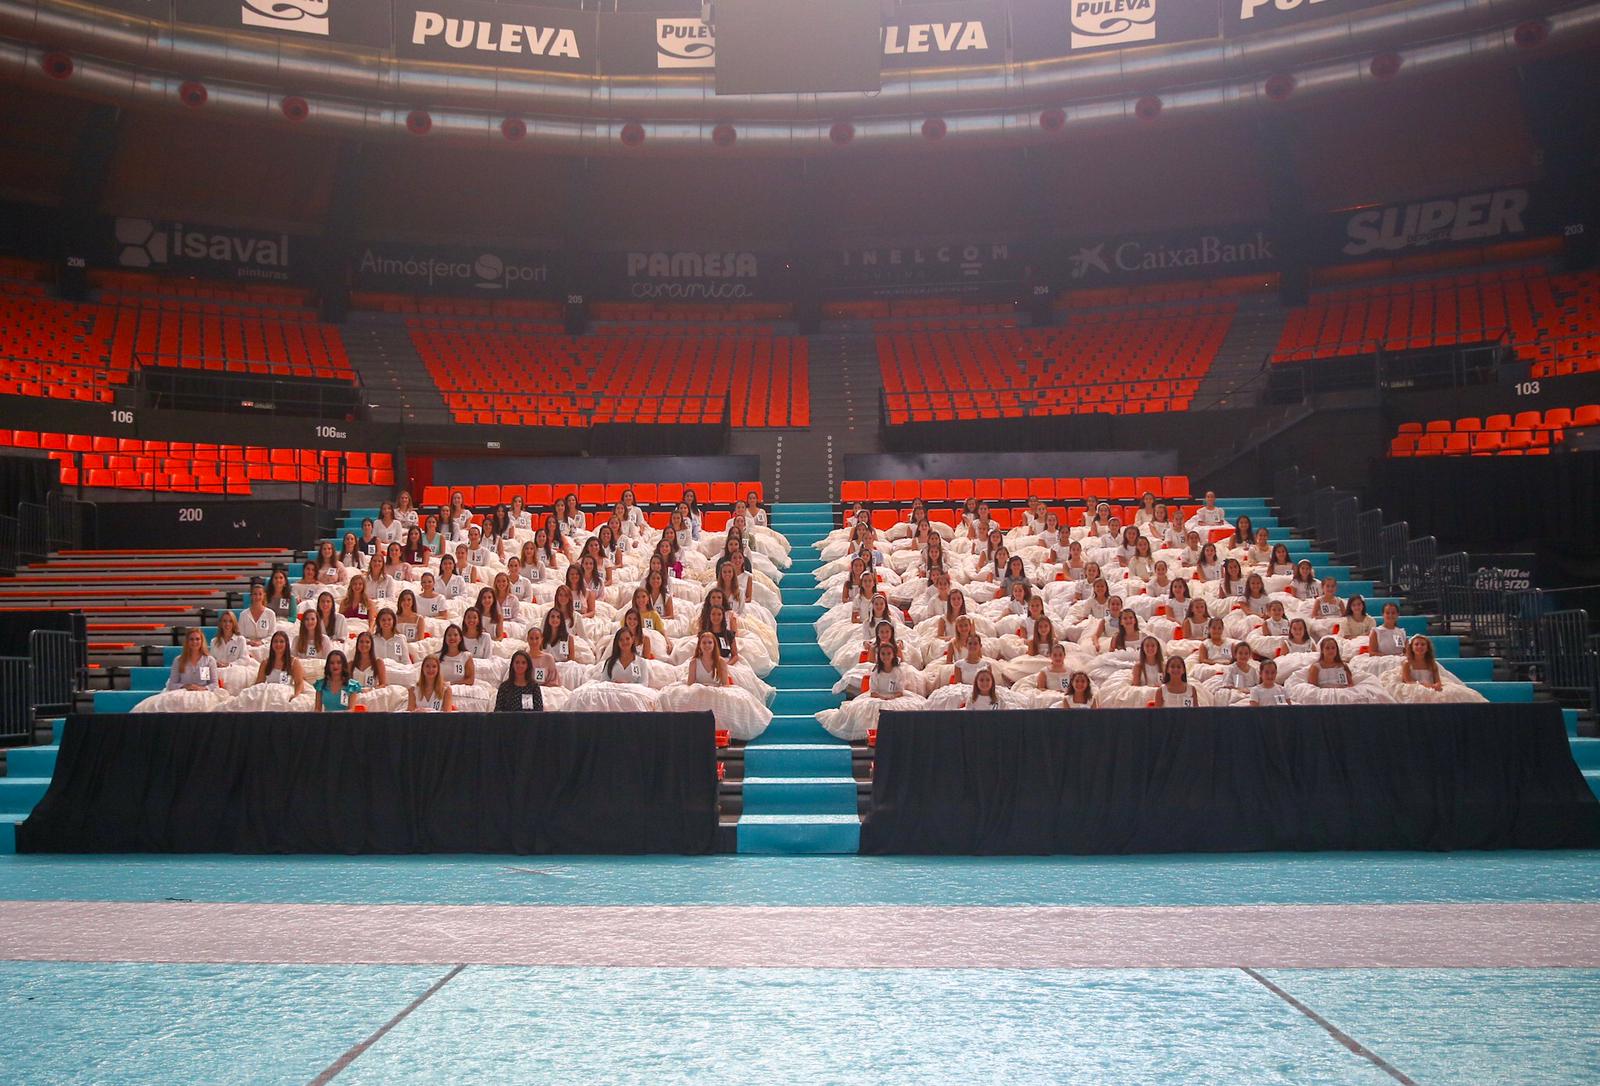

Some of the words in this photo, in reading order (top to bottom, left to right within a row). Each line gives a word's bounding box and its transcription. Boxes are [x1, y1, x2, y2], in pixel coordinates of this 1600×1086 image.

[1076, 0, 1150, 18] PULEVA
[412, 11, 580, 59] PULEVA
[880, 21, 988, 54] LEVA
[1343, 190, 1529, 255] SUPER
[1564, 223, 1584, 236] 203
[174, 223, 288, 266] isaval
[1114, 232, 1273, 271] CaixaBank
[237, 267, 288, 280] pinturas
[360, 250, 471, 285] Atmósfera
[627, 252, 757, 277] PAMESA
[567, 294, 583, 304] 205
[1514, 381, 1540, 395] 103
[110, 410, 133, 423] 106
[179, 508, 203, 521] 200
[456, 664, 463, 674] 19
